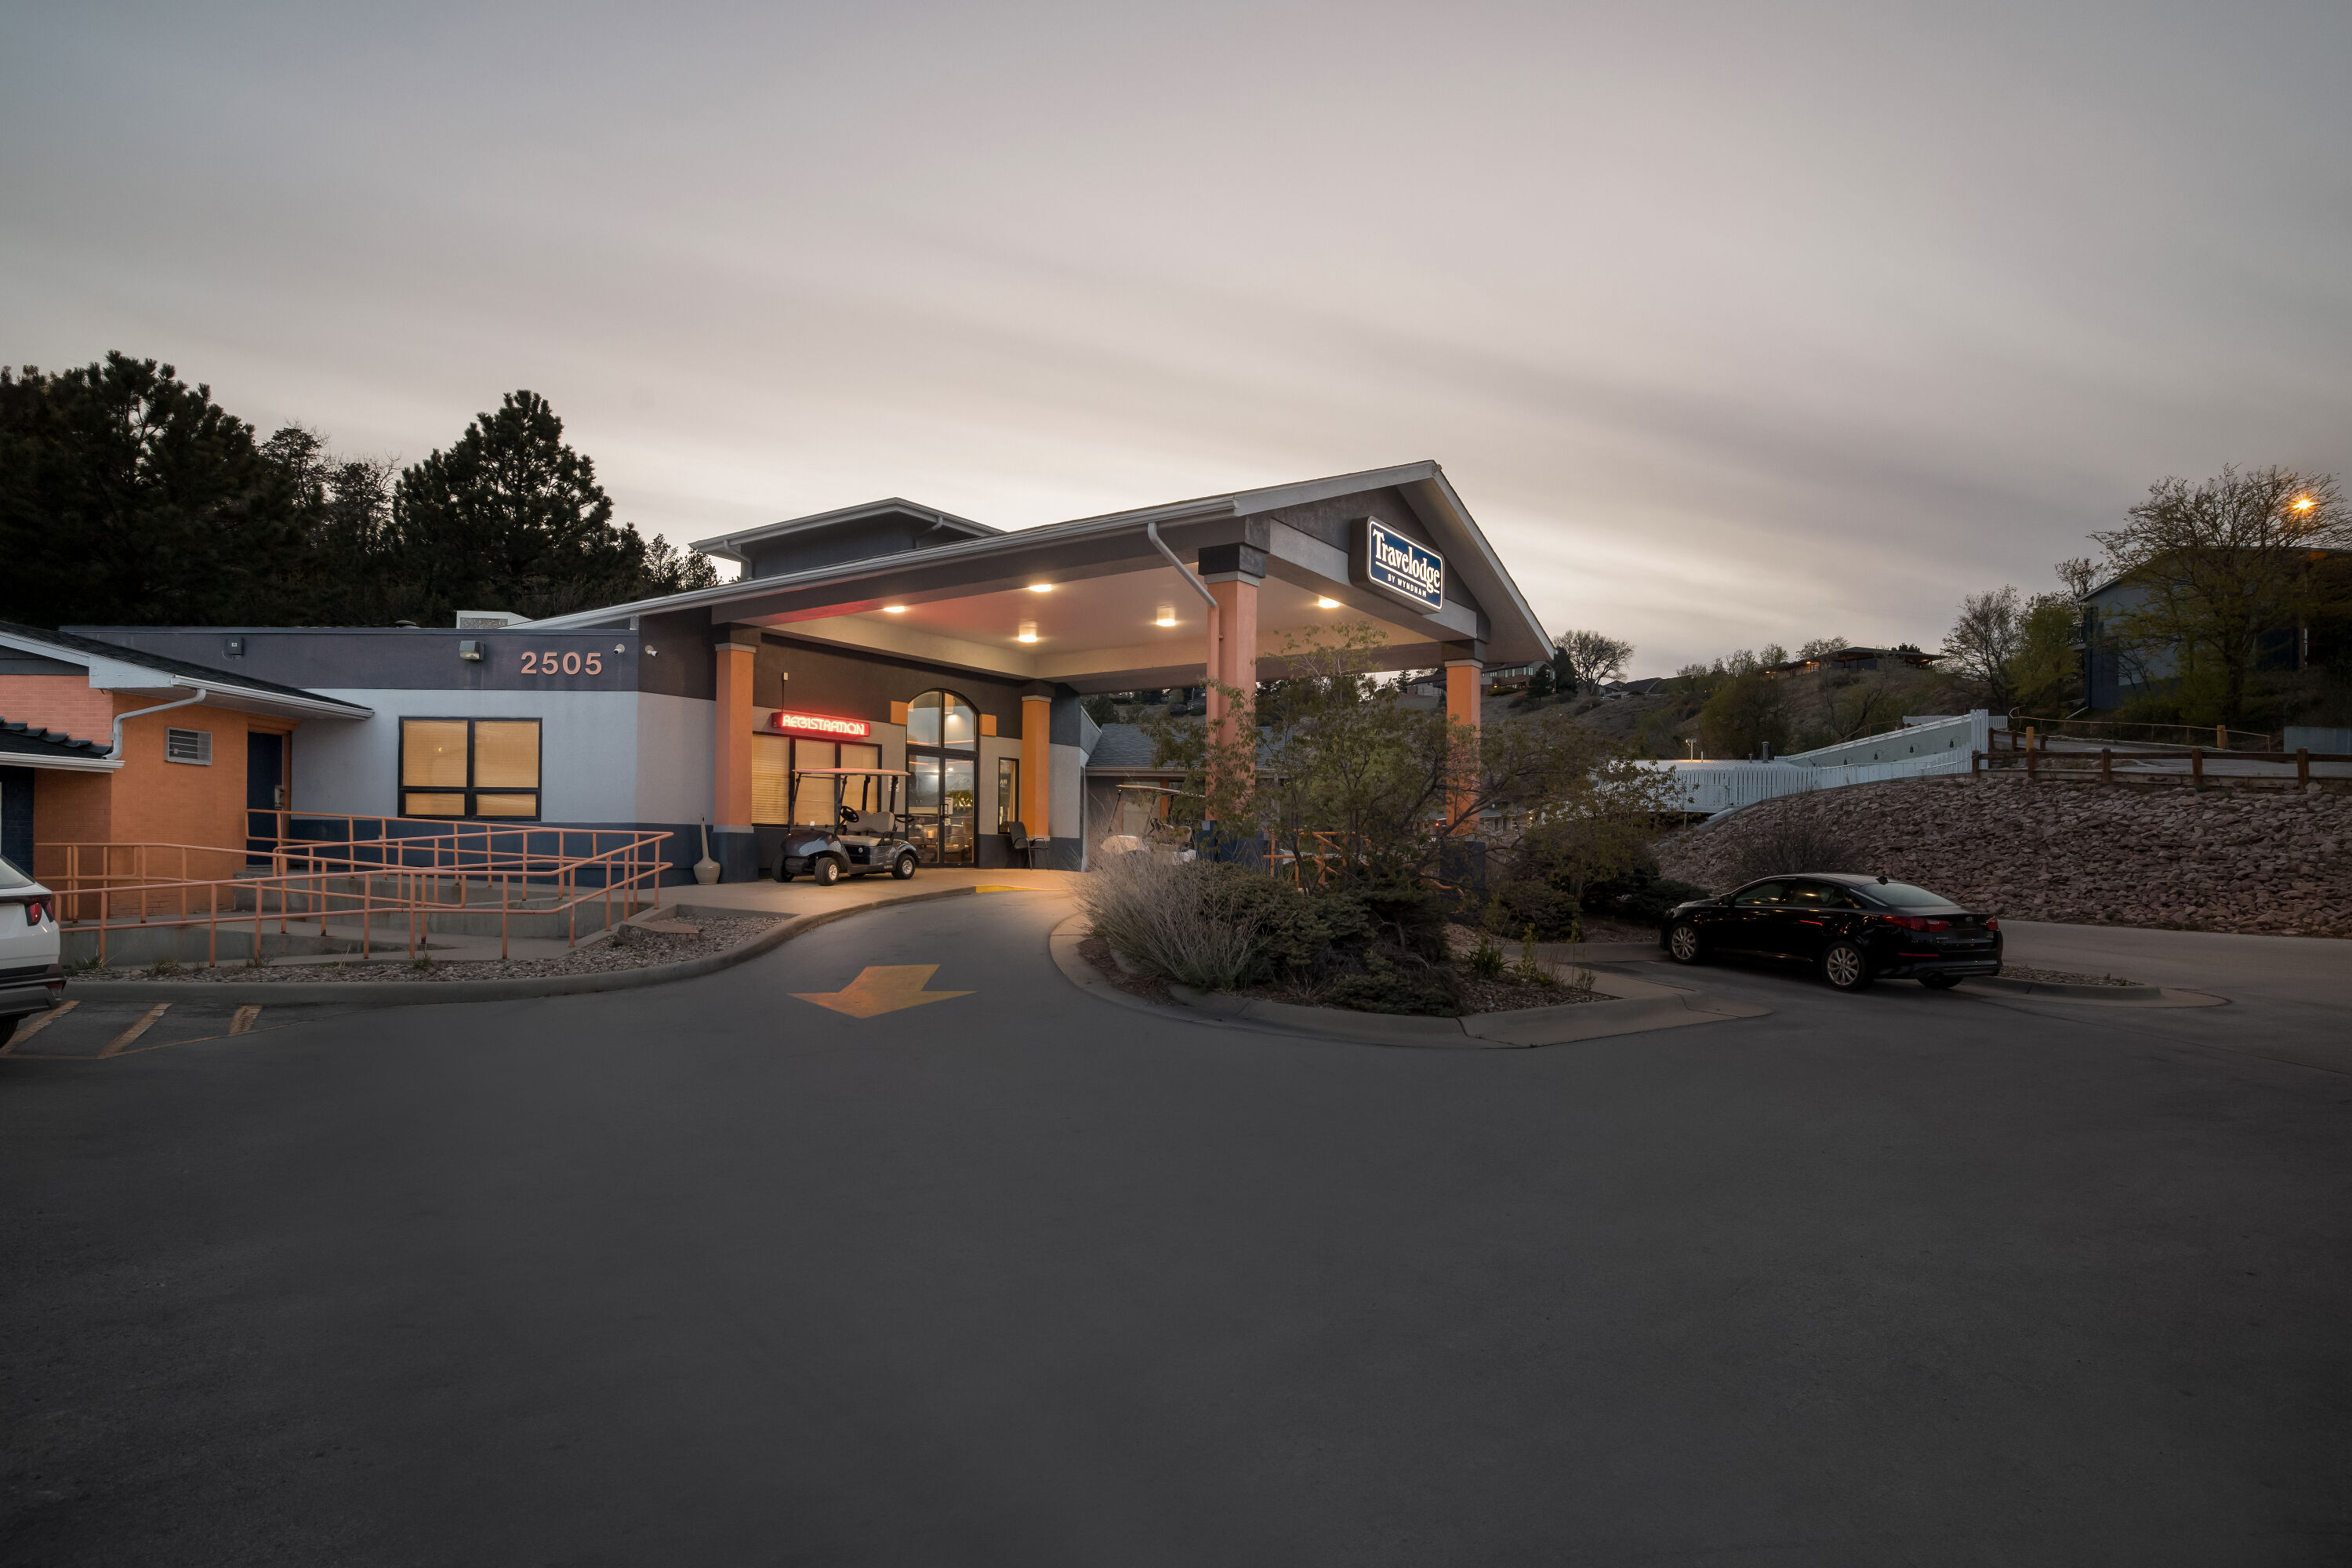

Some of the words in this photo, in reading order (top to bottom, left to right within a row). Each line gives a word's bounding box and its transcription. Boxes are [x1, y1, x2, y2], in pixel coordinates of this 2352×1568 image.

[1373, 528, 1440, 593] Travelodge
[1388, 573, 1396, 583] BY
[1397, 578, 1427, 598] WYNDHAM
[521, 652, 602, 675] 2505
[782, 714, 865, 735] REGISTRATION
